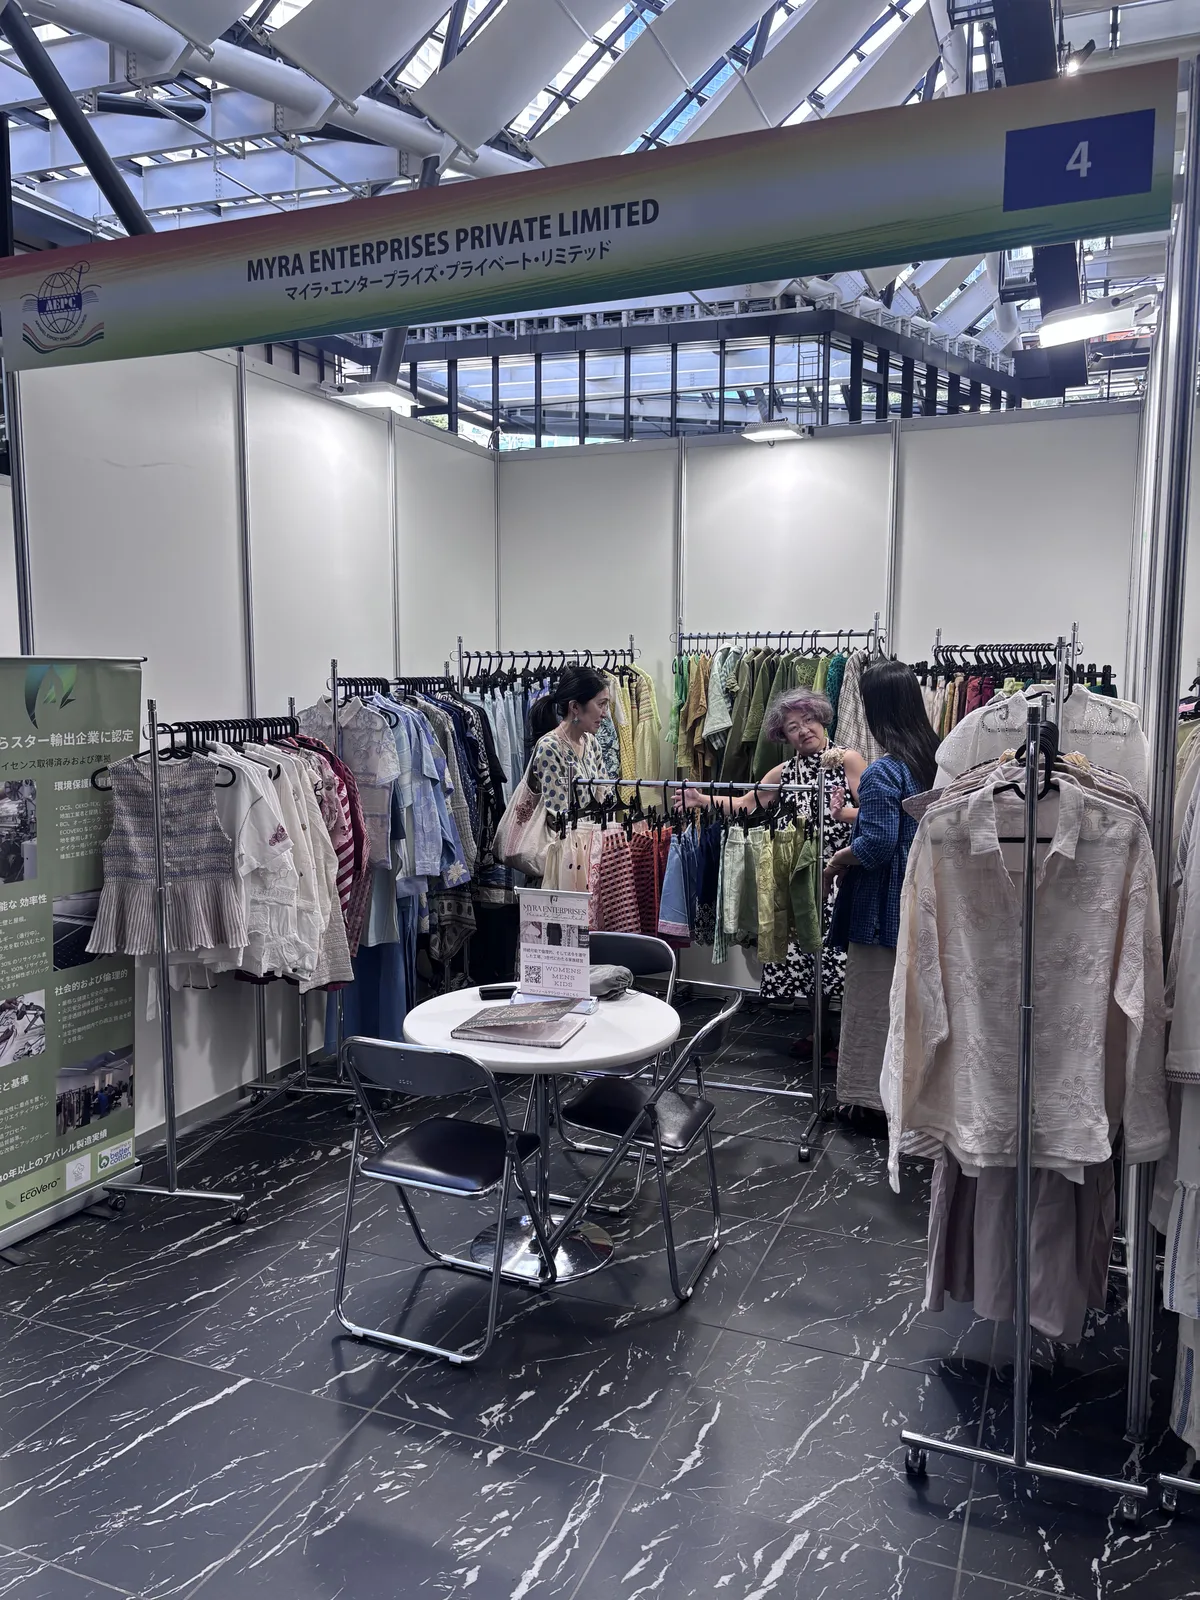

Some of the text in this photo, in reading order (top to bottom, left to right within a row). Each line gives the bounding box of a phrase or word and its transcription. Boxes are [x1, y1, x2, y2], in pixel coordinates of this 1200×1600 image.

[1066, 141, 1092, 178] 4
[247, 198, 660, 282] MYRA ENTERPRISES PRIVATE LIMITED
[46, 296, 76, 311] AEPC
[545, 966, 581, 974] WOMENS
[551, 973, 575, 981] MENS
[55, 969, 128, 996] 社会的および倫理的
